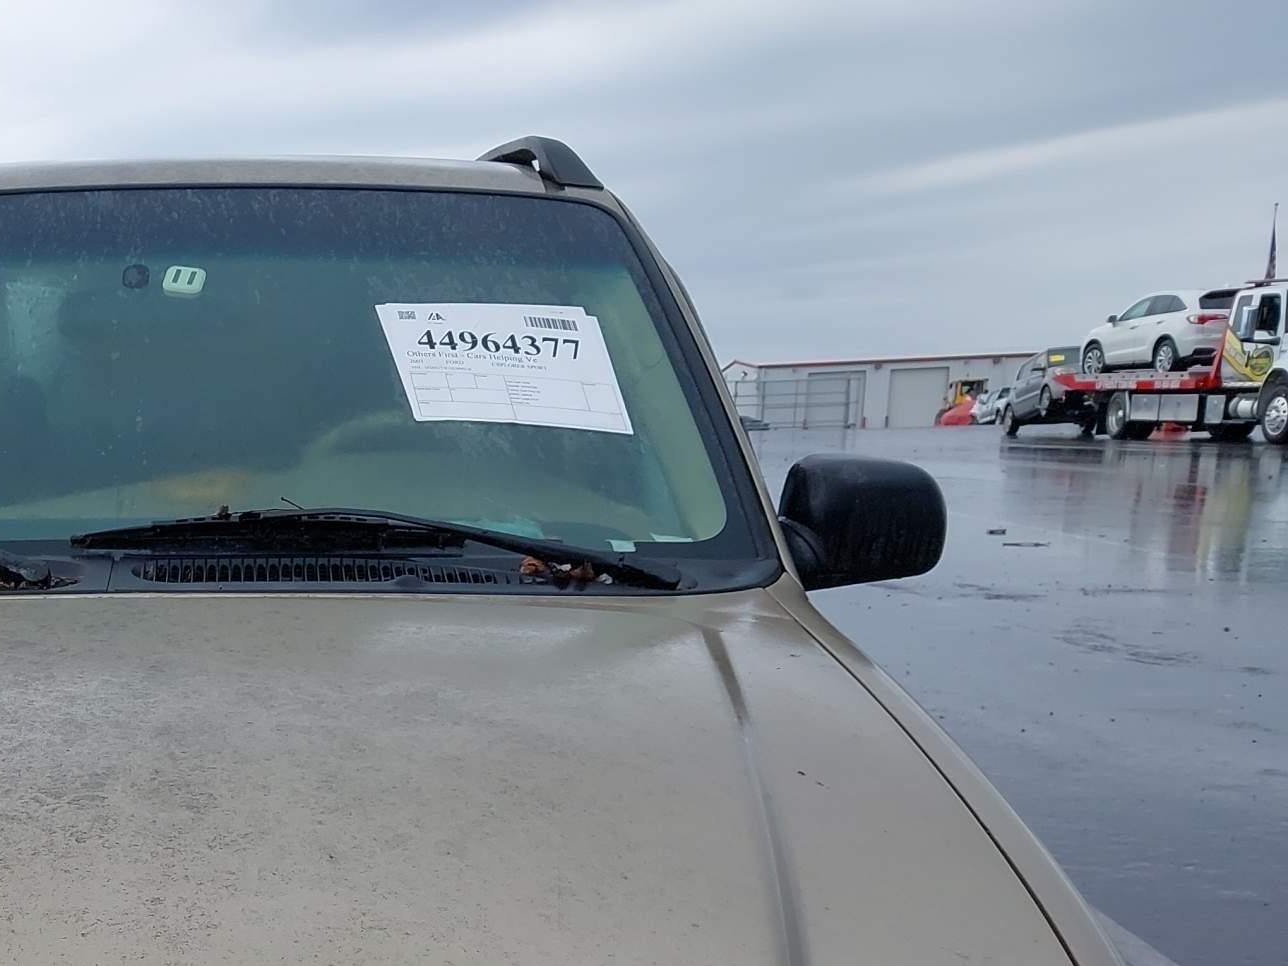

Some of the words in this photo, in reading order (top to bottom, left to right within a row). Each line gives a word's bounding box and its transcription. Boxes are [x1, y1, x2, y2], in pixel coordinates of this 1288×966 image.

[418, 329, 580, 360] 44964377
[406, 350, 436, 358] Others
[438, 351, 458, 359] First
[466, 352, 487, 360] Cars
[489, 353, 523, 363] Helping
